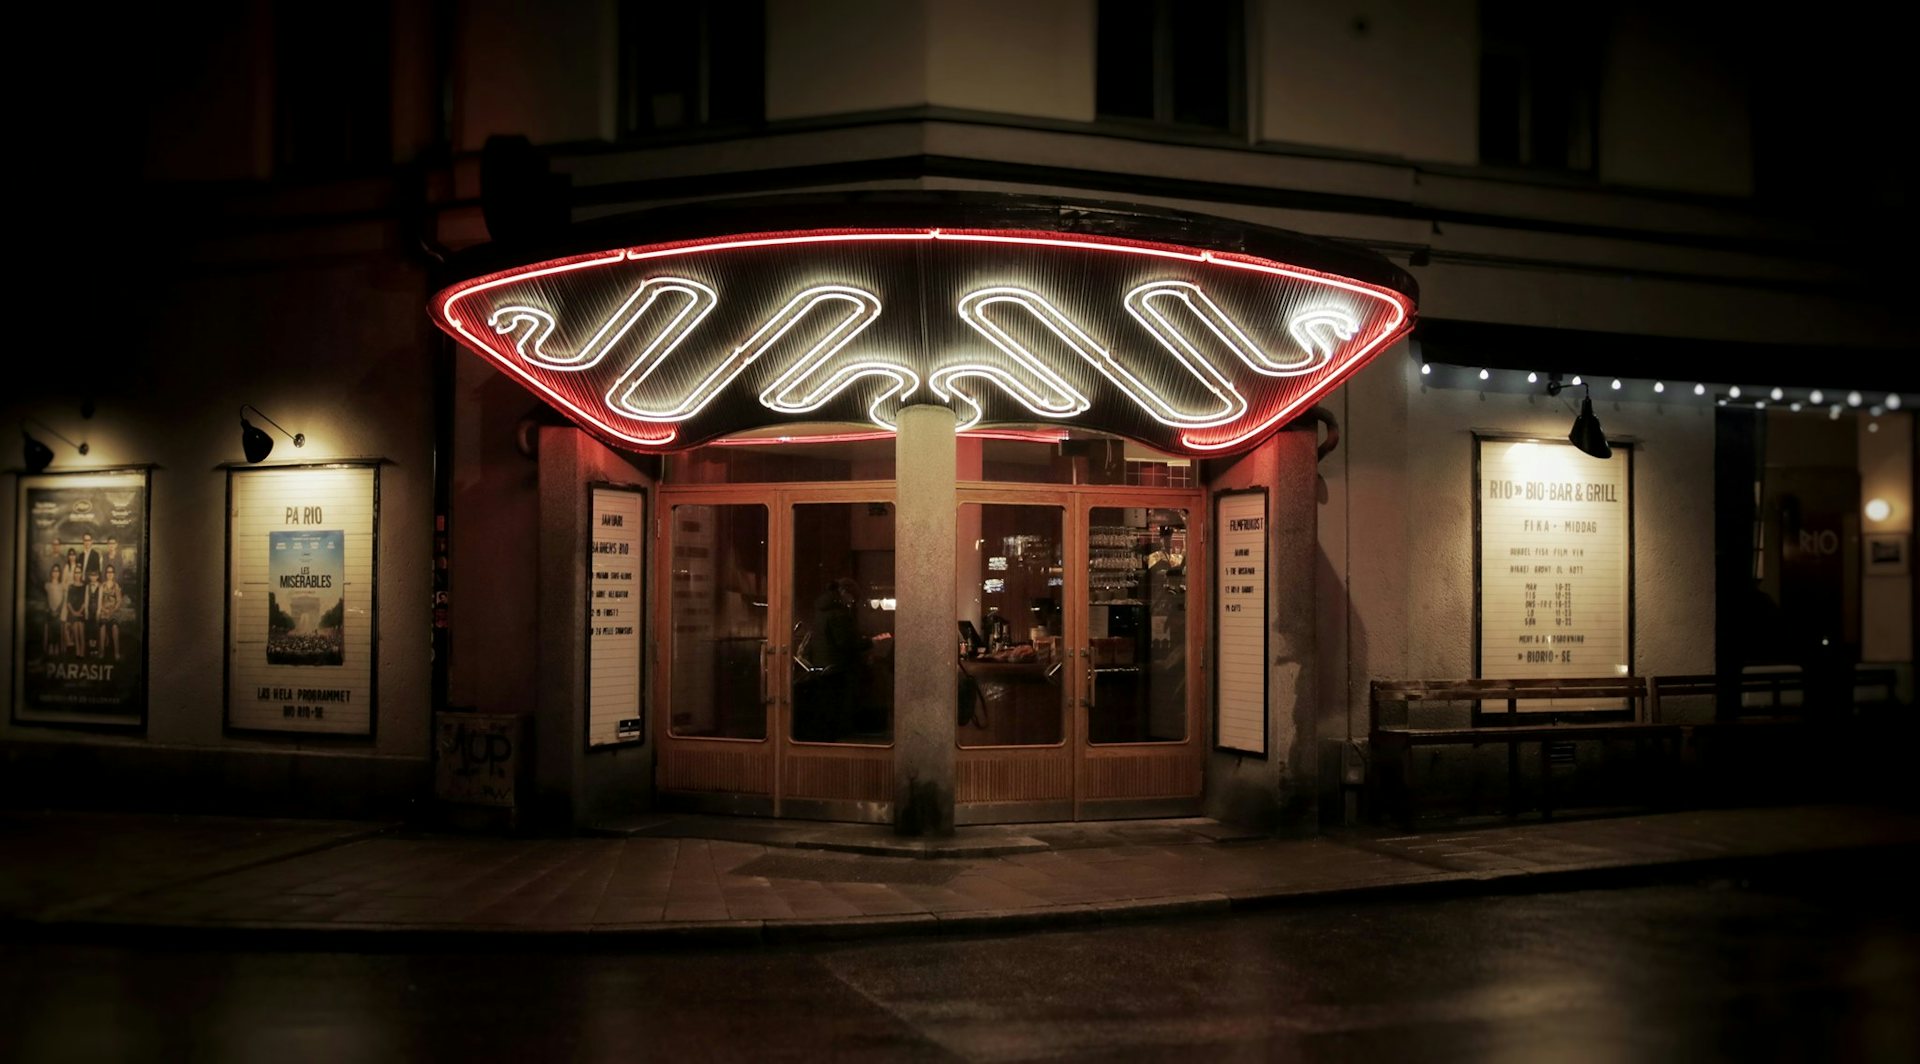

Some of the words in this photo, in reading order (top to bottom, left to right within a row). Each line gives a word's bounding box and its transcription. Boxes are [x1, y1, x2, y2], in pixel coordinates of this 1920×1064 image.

[1586, 484, 1618, 502] GRILL
[304, 506, 323, 525] RIO
[1524, 520, 1549, 531] FIKA
[1565, 521, 1597, 533] MIDDAG
[1800, 528, 1839, 555] RIO
[1553, 548, 1568, 557] FILM
[300, 567, 310, 575] LES
[280, 575, 332, 588] MISÉRABLES
[46, 662, 114, 681] PARASIT
[273, 688, 292, 701] HELA
[297, 689, 351, 702] PROGRAMMET
